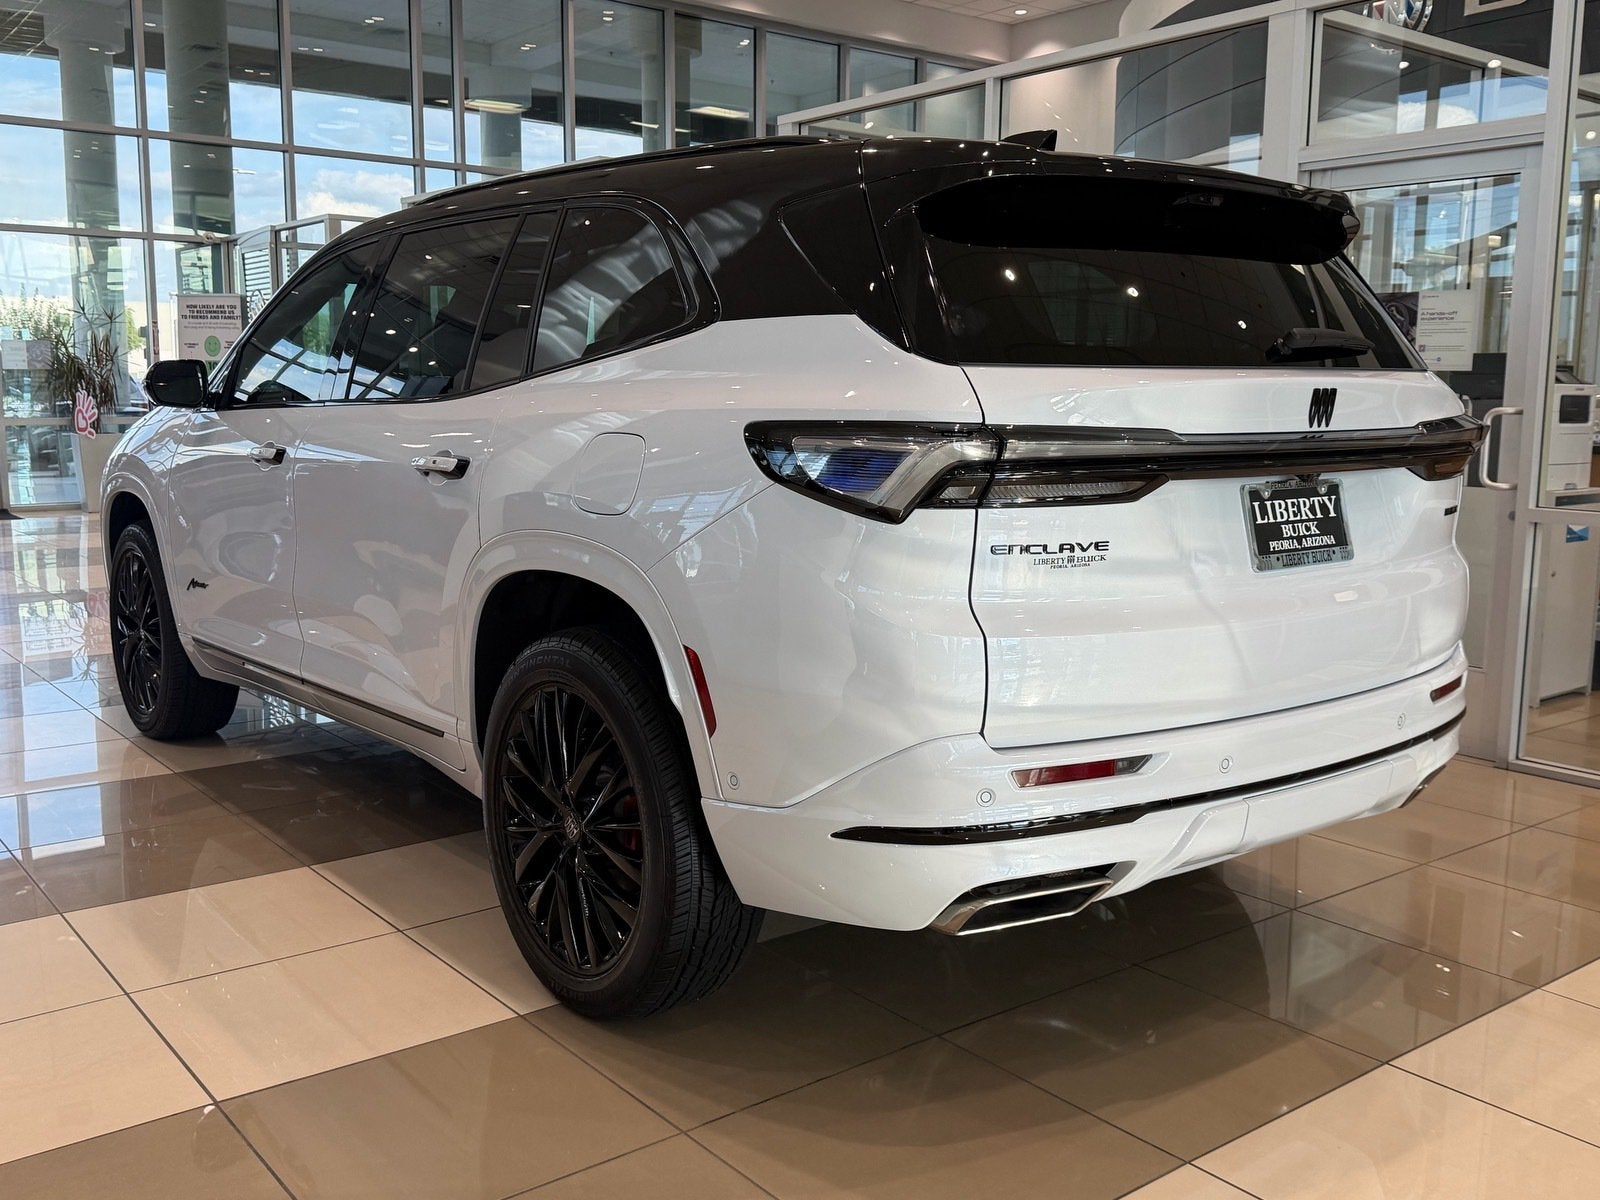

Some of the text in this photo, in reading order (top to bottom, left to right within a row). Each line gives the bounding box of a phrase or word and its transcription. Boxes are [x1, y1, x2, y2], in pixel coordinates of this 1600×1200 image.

[1252, 496, 1337, 524] LIBERTY
[1281, 521, 1320, 537] BUICK
[990, 541, 1110, 555] ENCLAVE
[1269, 535, 1336, 551] PEORIA, ARIZONA
[1033, 554, 1107, 565] LIBERTY BUICK
[1281, 550, 1332, 567] LIBERTY BUICK
